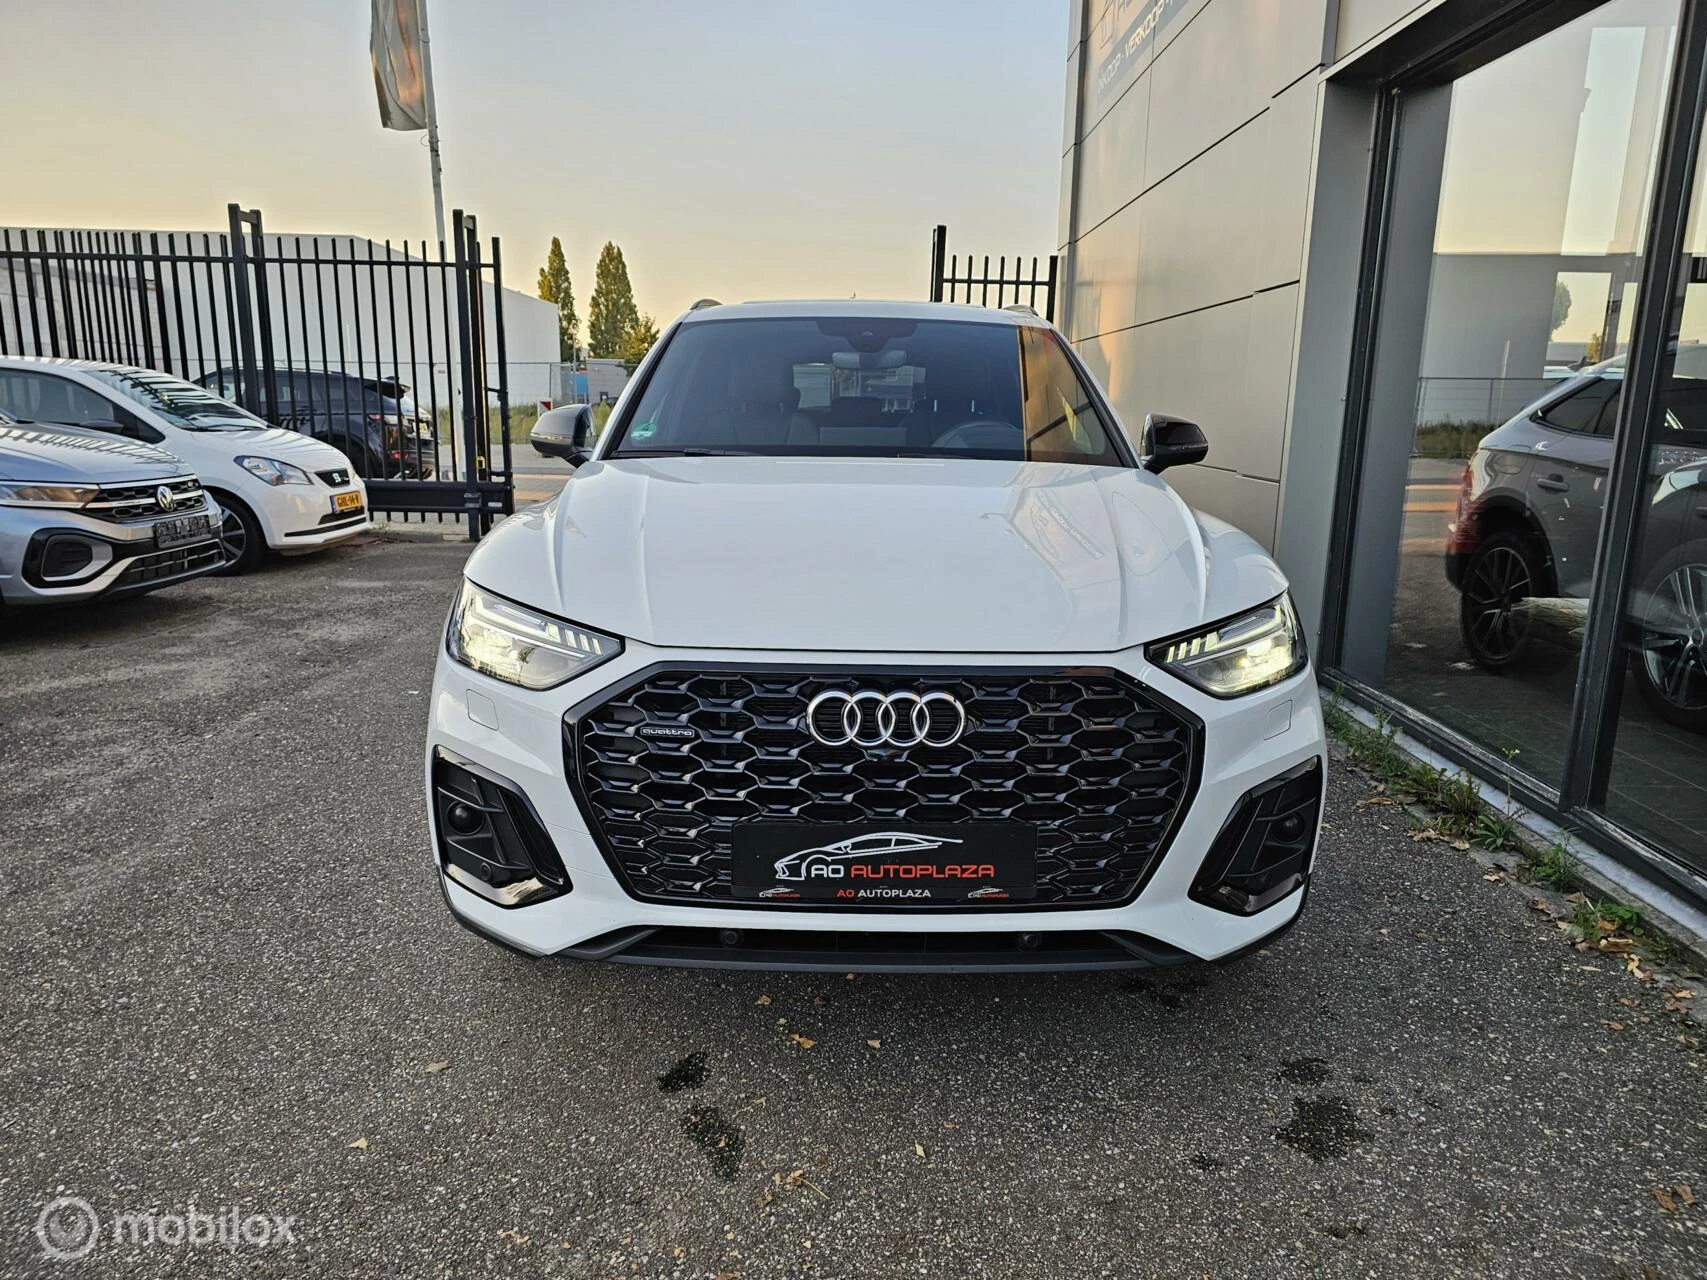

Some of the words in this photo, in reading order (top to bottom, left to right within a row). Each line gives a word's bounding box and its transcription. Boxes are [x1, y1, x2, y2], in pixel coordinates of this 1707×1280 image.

[642, 728, 692, 736] quattro
[811, 864, 845, 878] AO
[851, 864, 995, 878] AUTOPLAZA
[836, 889, 855, 898] AO
[857, 889, 932, 898] AUTOPLAZA
